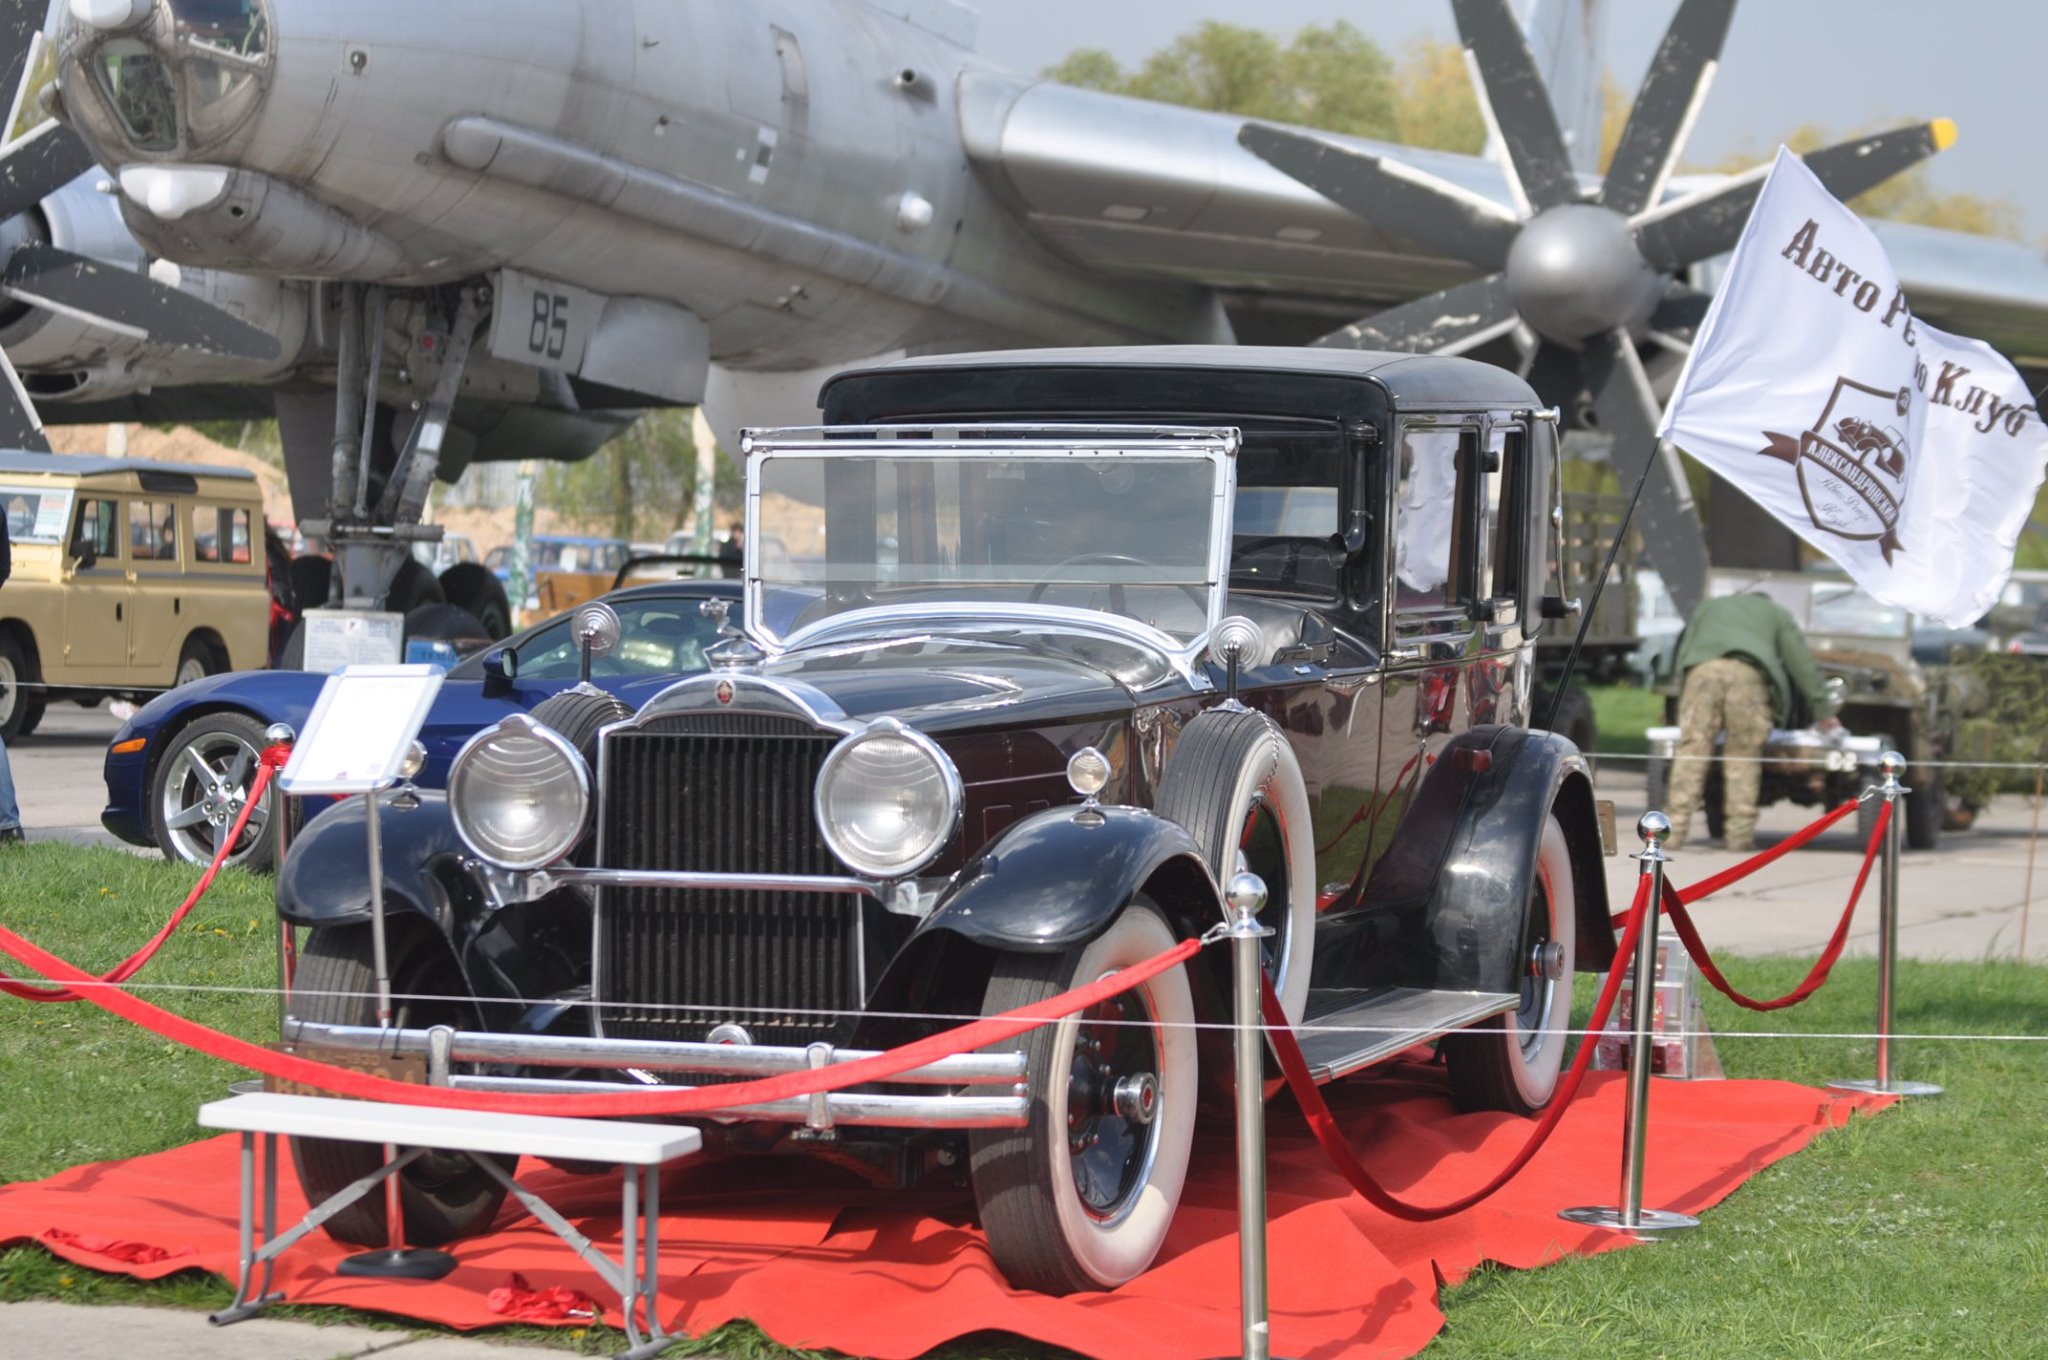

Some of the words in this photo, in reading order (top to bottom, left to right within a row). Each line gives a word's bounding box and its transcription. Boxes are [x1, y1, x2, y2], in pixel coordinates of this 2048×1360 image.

[529, 290, 569, 360] 85
[1781, 218, 1881, 313] Авто
[1929, 360, 2037, 437] Клуб
